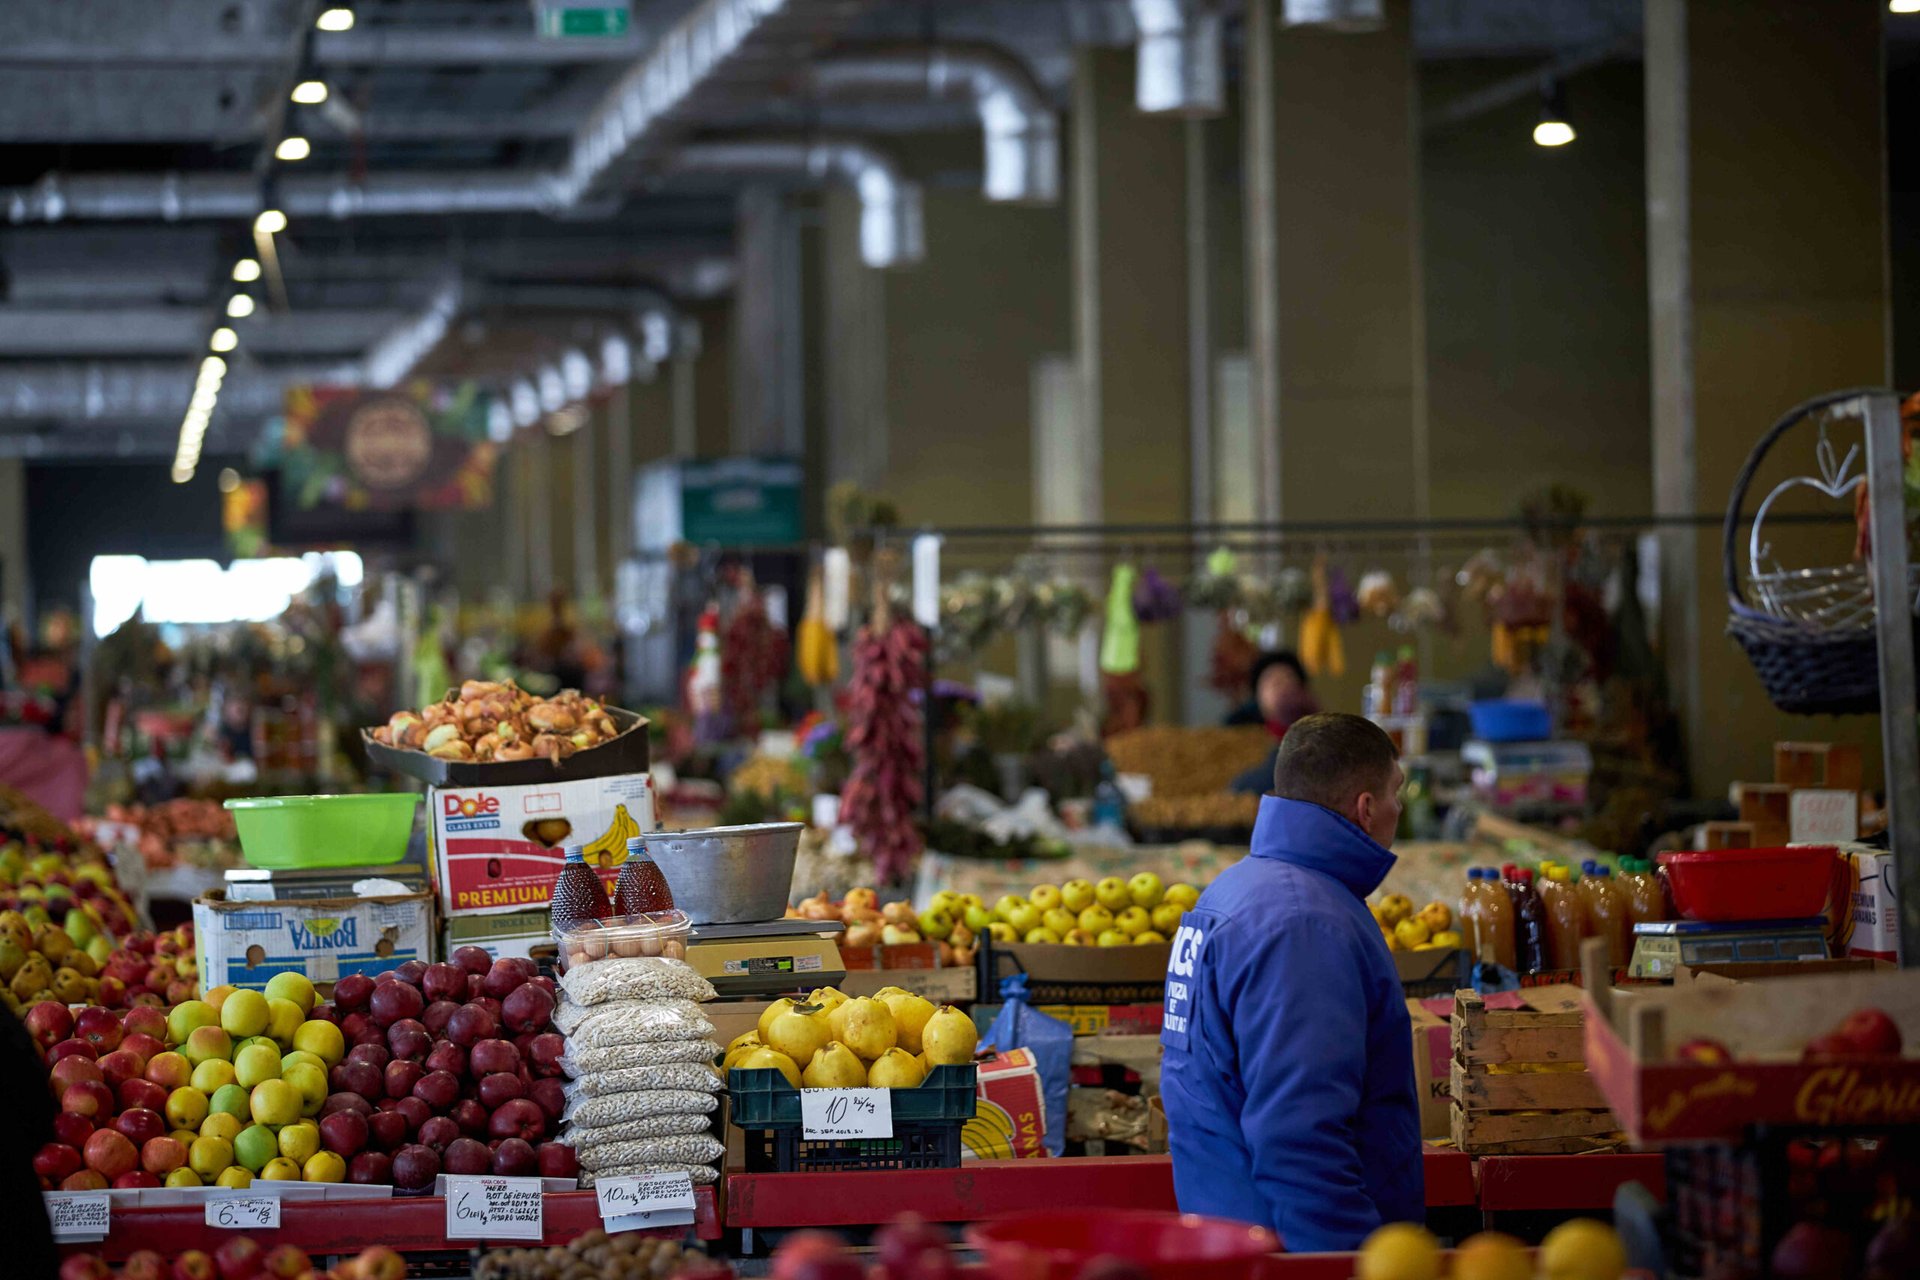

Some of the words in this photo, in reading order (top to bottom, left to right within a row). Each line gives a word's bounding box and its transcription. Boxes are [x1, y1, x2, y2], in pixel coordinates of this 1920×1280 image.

[444, 793, 500, 817] Dole
[447, 820, 472, 832] CLASS
[473, 819, 499, 830] EXTRA
[458, 885, 549, 907] PREMIUM
[287, 916, 358, 950] BONITA
[825, 1096, 848, 1125] 10
[1018, 1111, 1040, 1158] ANAS
[456, 1192, 471, 1220] 6
[603, 1186, 624, 1203] 10
